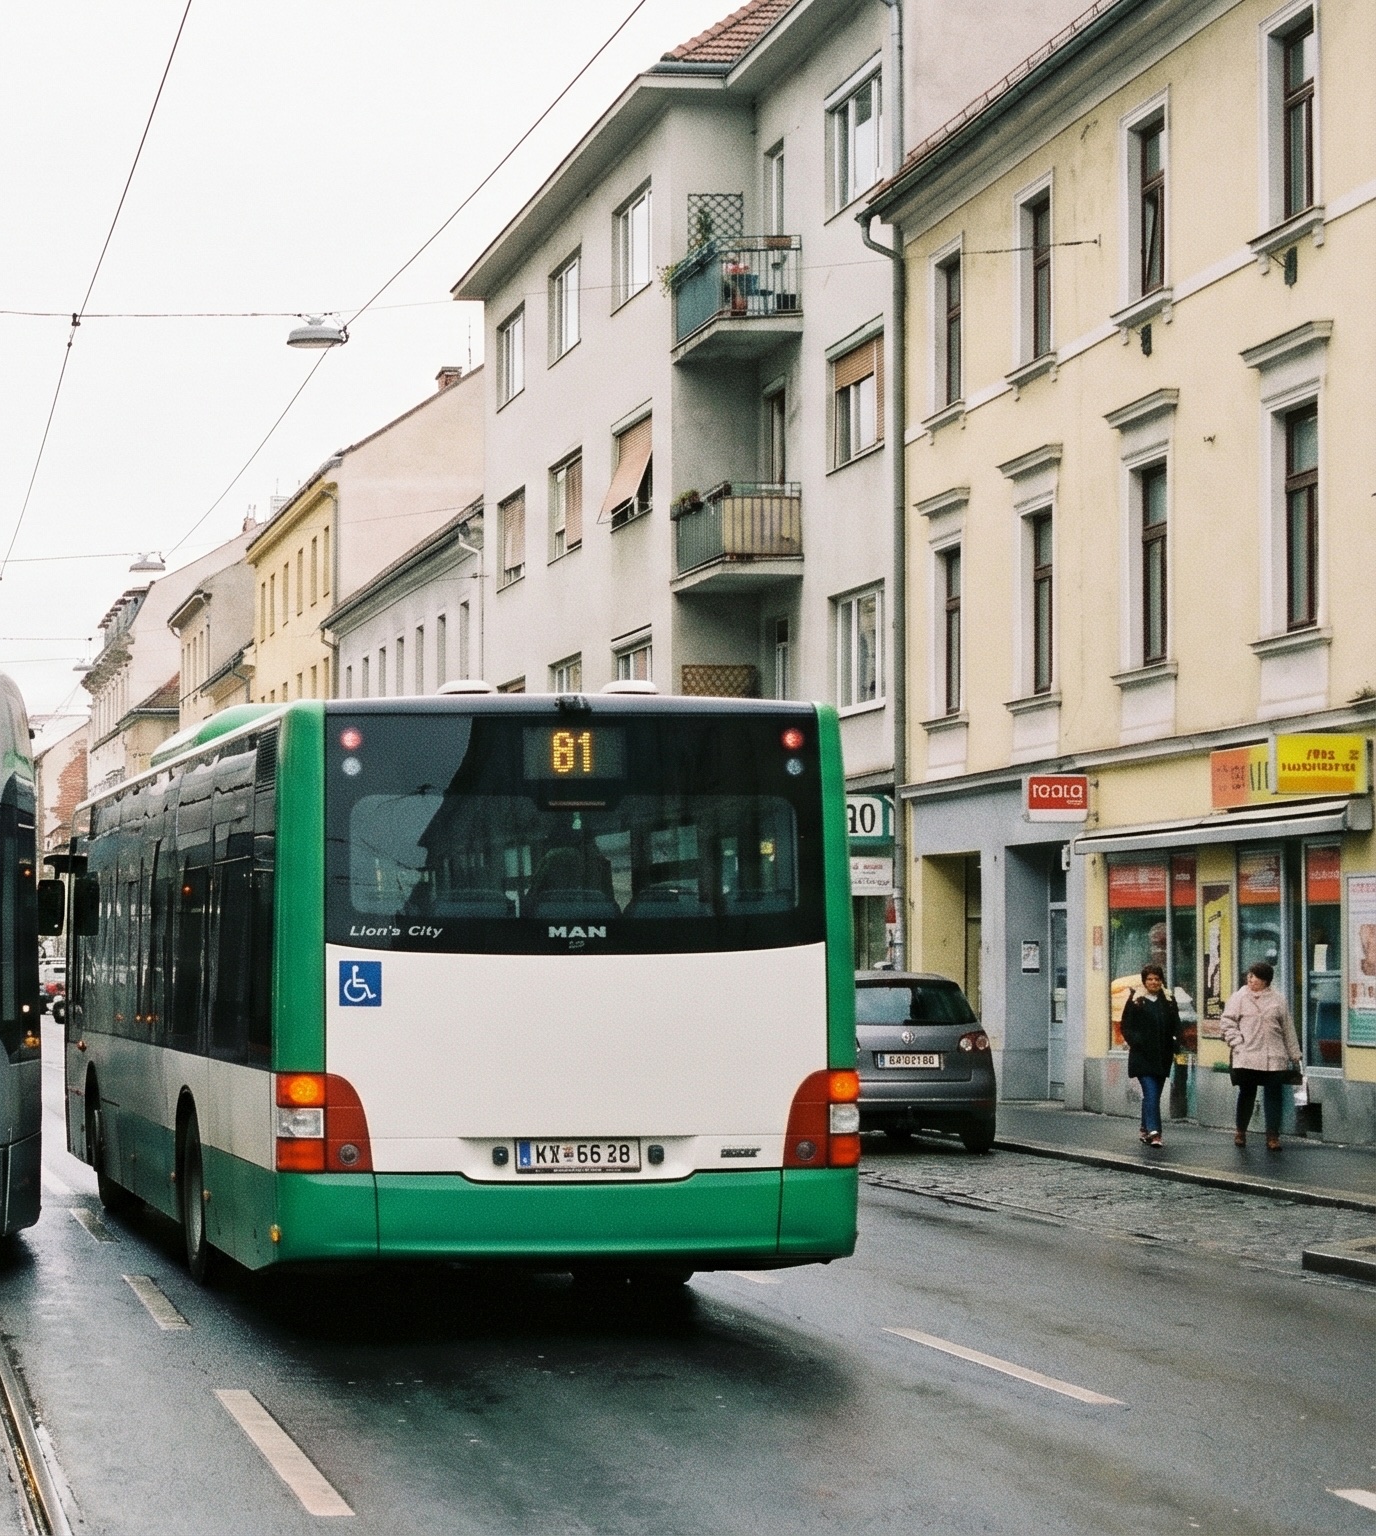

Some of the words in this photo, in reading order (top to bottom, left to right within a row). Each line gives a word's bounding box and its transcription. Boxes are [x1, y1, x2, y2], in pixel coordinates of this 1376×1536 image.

[349, 925, 401, 937] Lion's
[407, 925, 443, 940] City
[548, 926, 607, 938] MAN
